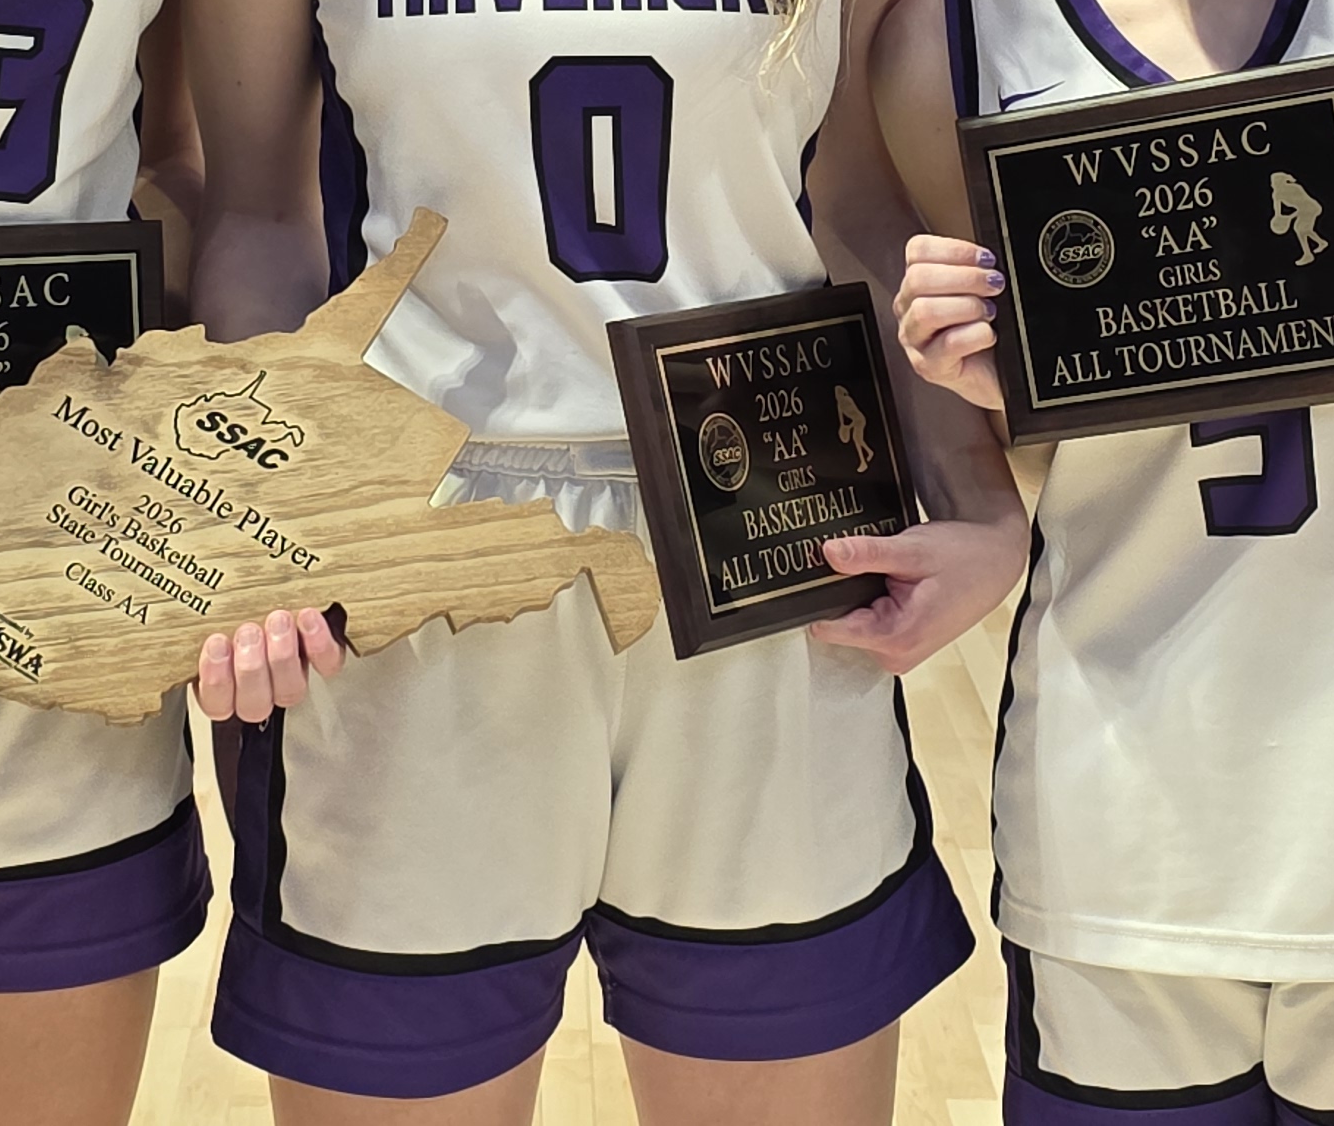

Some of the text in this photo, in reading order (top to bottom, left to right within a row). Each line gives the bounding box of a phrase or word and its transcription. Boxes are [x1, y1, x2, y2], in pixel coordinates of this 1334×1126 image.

[529, 55, 674, 284] 0
[1063, 121, 1271, 185] WVSSAC
[1134, 177, 1214, 217] 2026
[1058, 243, 1105, 265] SSAC
[1158, 259, 1222, 288] GIRLS
[1095, 279, 1299, 338] BASKETBALL
[705, 336, 832, 389] WVSSAC
[1051, 350, 1112, 387] ALL
[755, 386, 805, 423] 2026
[195, 411, 290, 469] SSAC
[51, 394, 321, 572] Most Valuable Player
[778, 465, 817, 493] GIRLS
[67, 485, 225, 591] Girl's Basketball
[132, 494, 188, 536] 2026
[743, 486, 864, 540] BASKETBALL
[46, 503, 214, 616] State Tournament
[721, 553, 760, 591] ALL
[65, 562, 152, 625] Class AA
